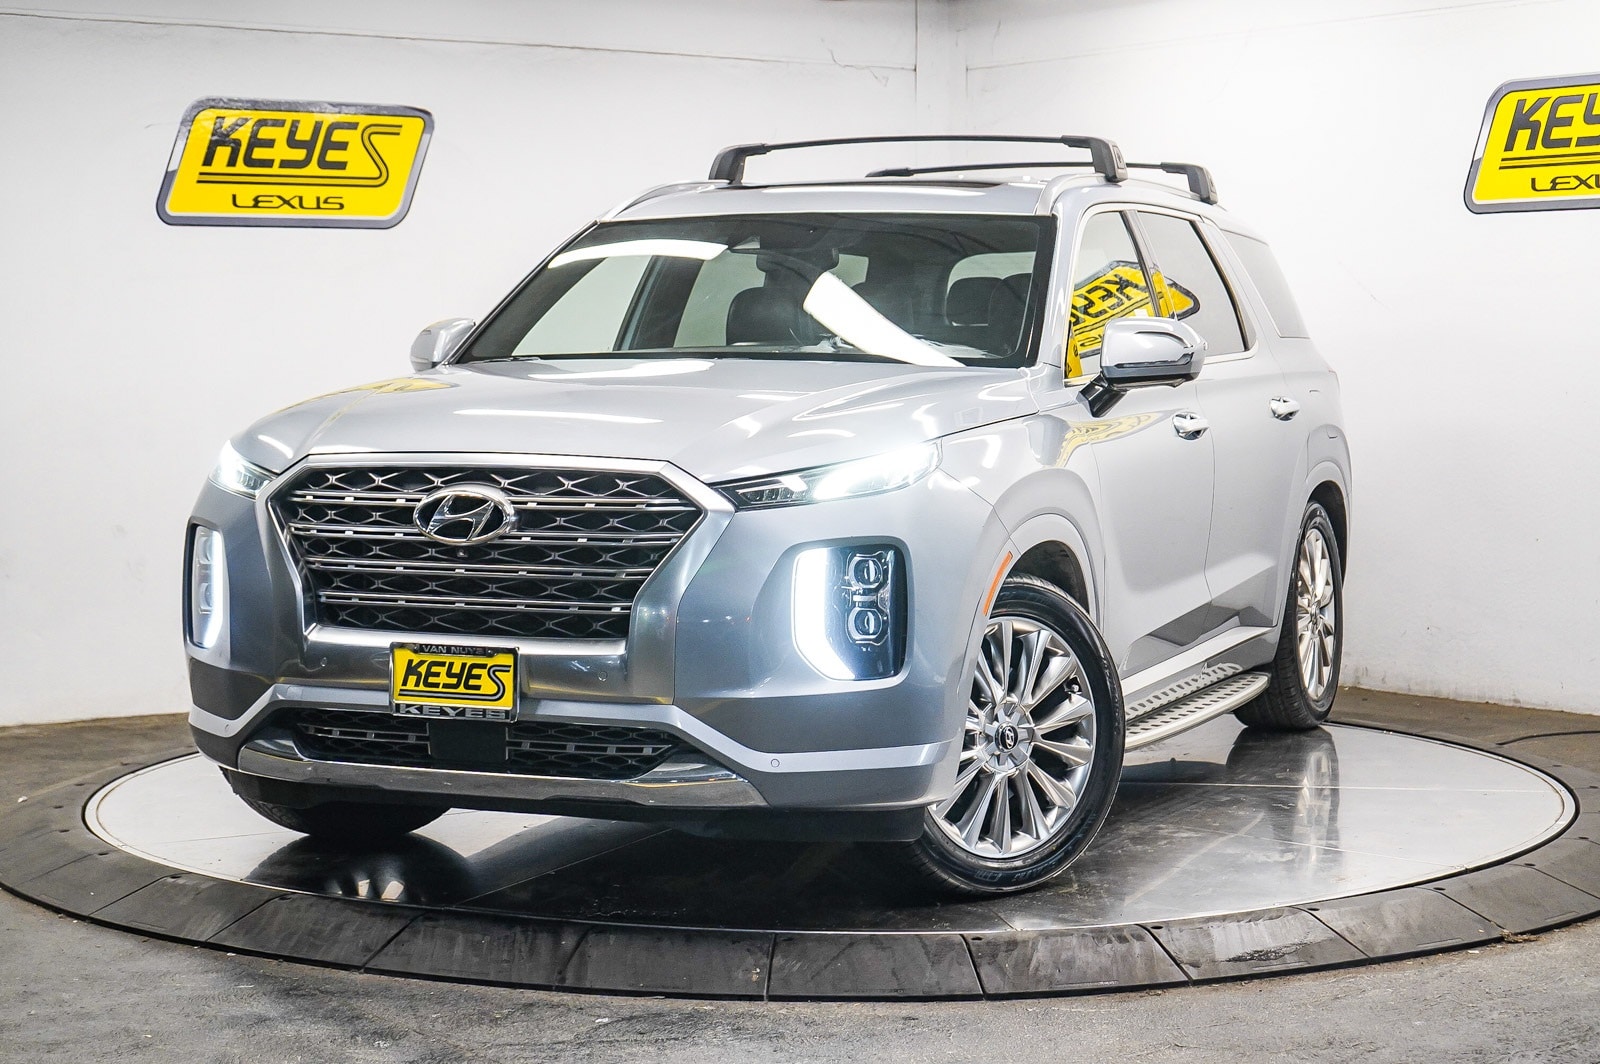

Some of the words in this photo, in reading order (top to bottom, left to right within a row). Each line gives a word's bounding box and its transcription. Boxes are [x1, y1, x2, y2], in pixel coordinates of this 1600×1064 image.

[197, 115, 403, 188] KEYES
[231, 193, 345, 211] LEXUS
[422, 644, 447, 654] VAN
[398, 658, 512, 702] KEYES
[400, 703, 506, 720] KEYES
